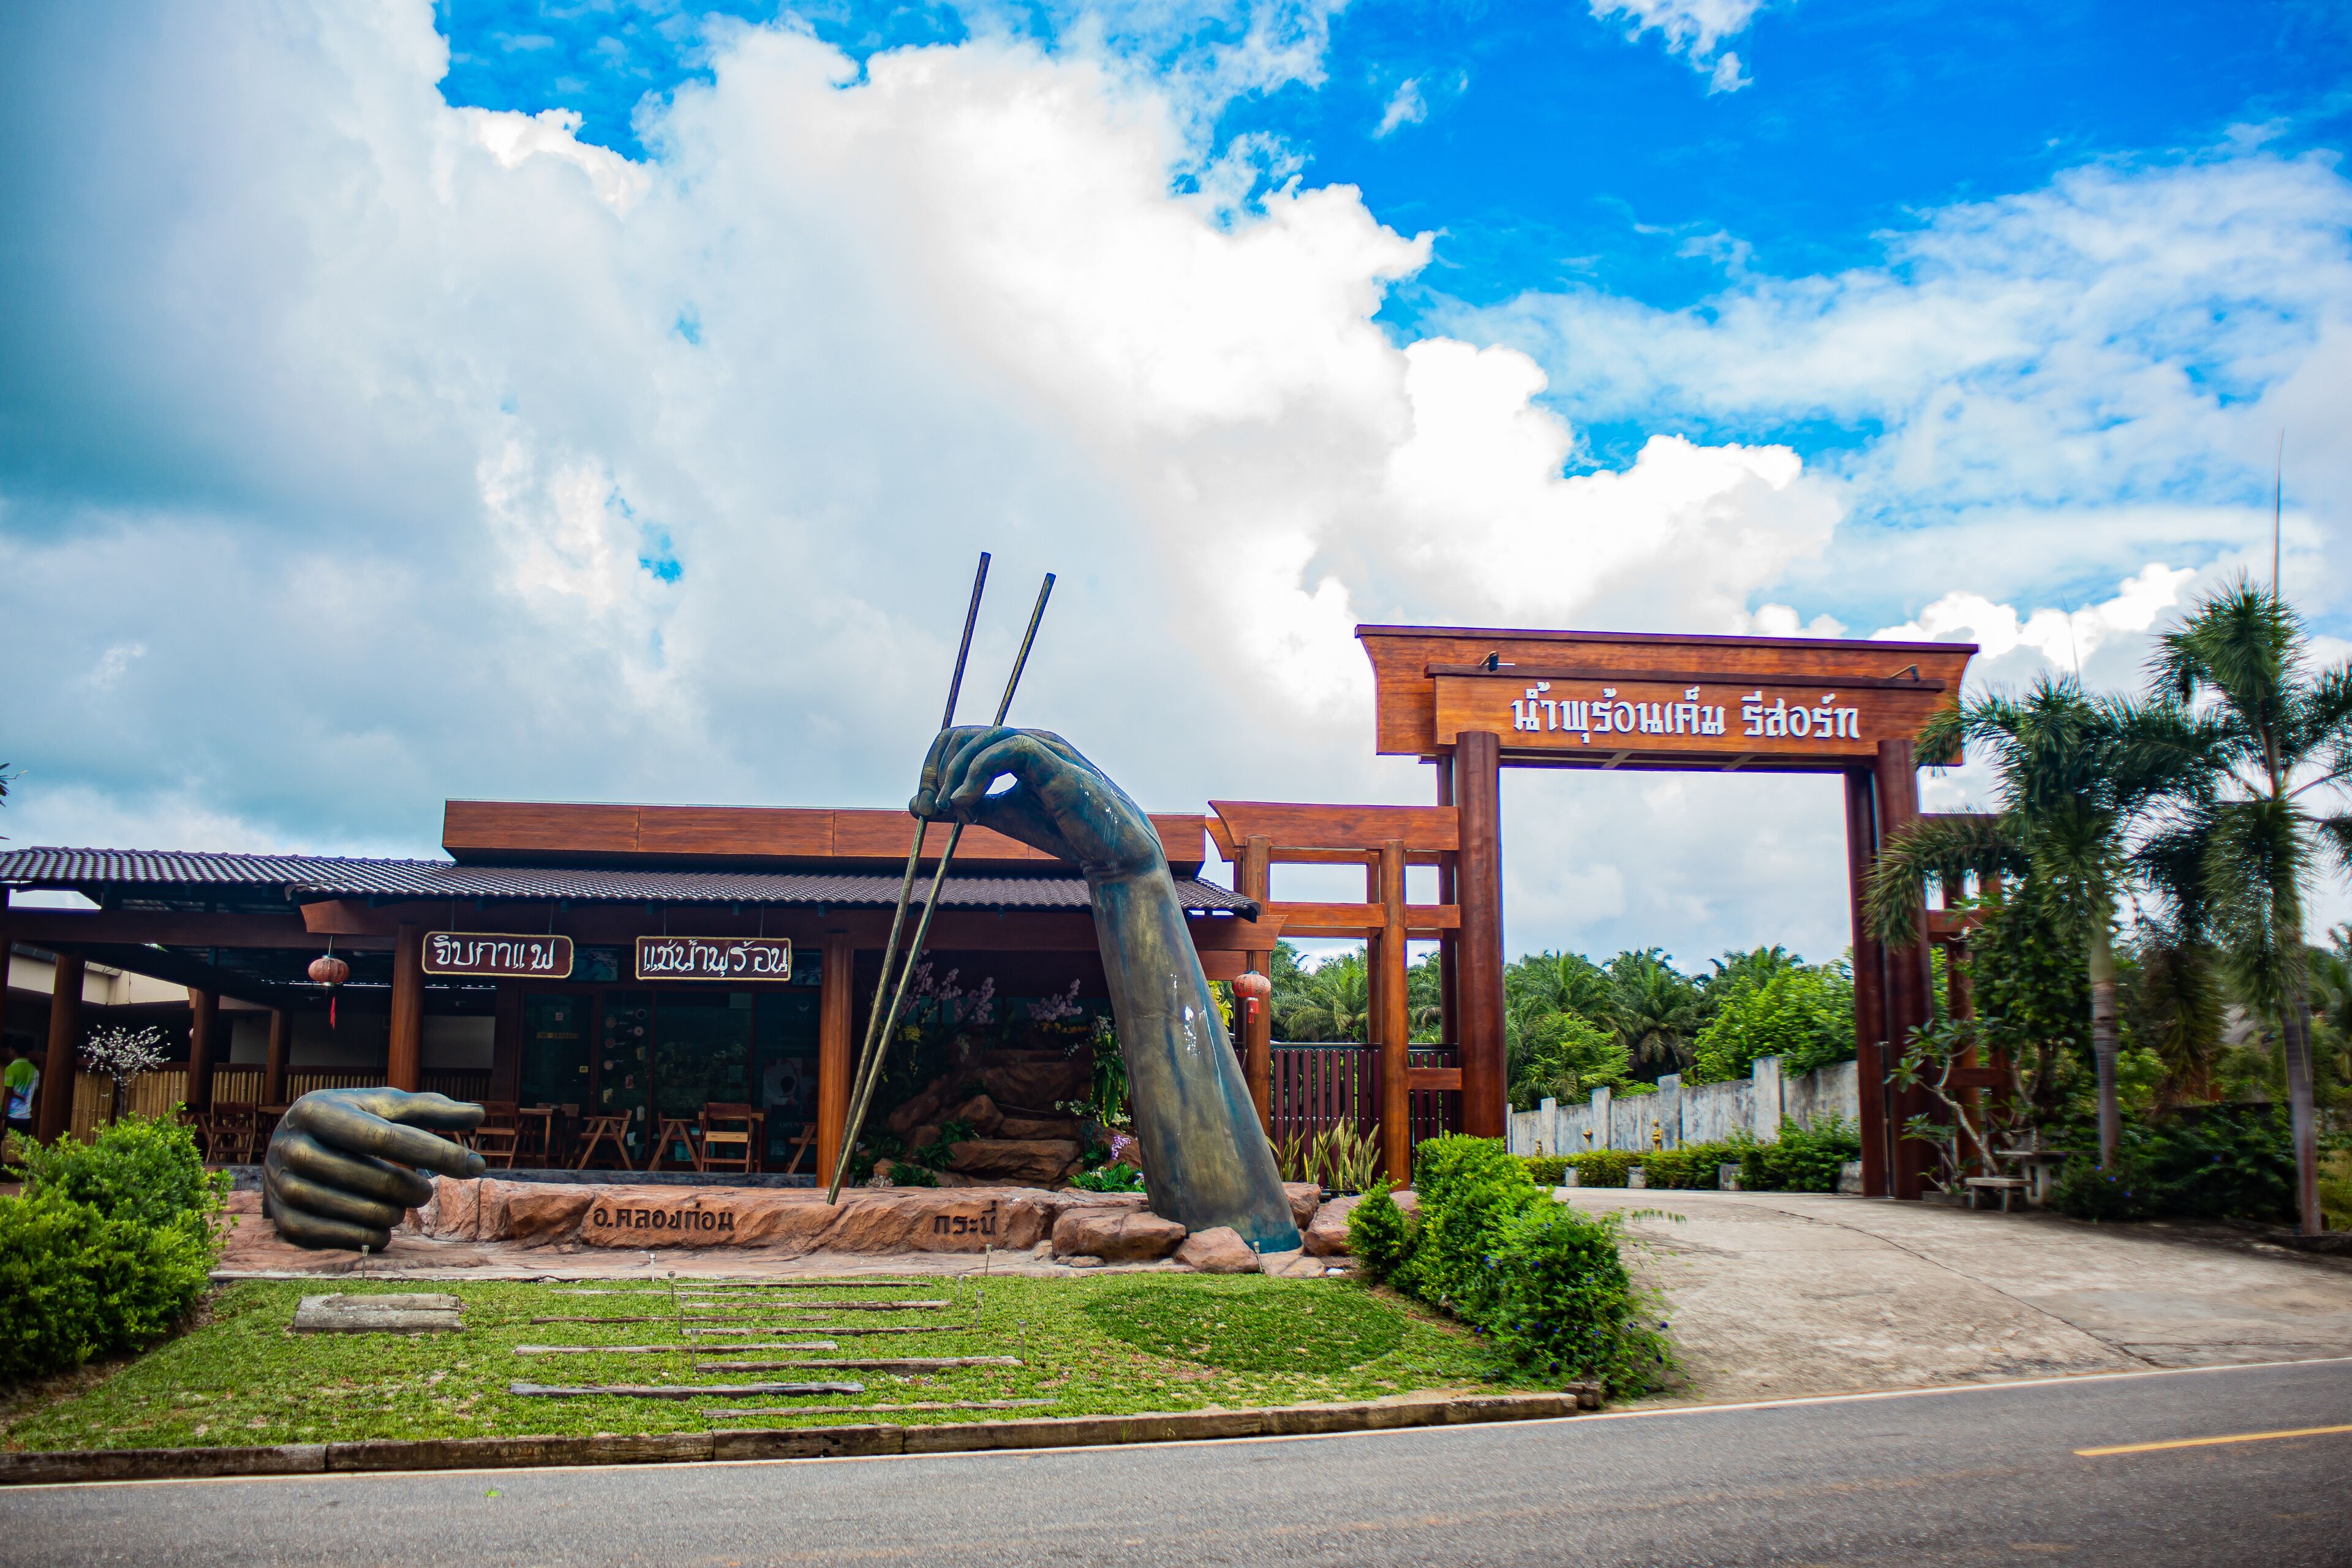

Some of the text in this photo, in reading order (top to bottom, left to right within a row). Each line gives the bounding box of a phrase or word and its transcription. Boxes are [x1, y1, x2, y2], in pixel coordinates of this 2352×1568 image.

[1510, 681, 1861, 744] น้ำพุร้อนเค็ม รีสอร์ท
[433, 935, 555, 971] จิบกาแฟ
[643, 939, 788, 977] แช่น้ำพุร้อน
[593, 1202, 734, 1231] อ.คลองท่อม
[933, 1199, 997, 1235] กระบี่
